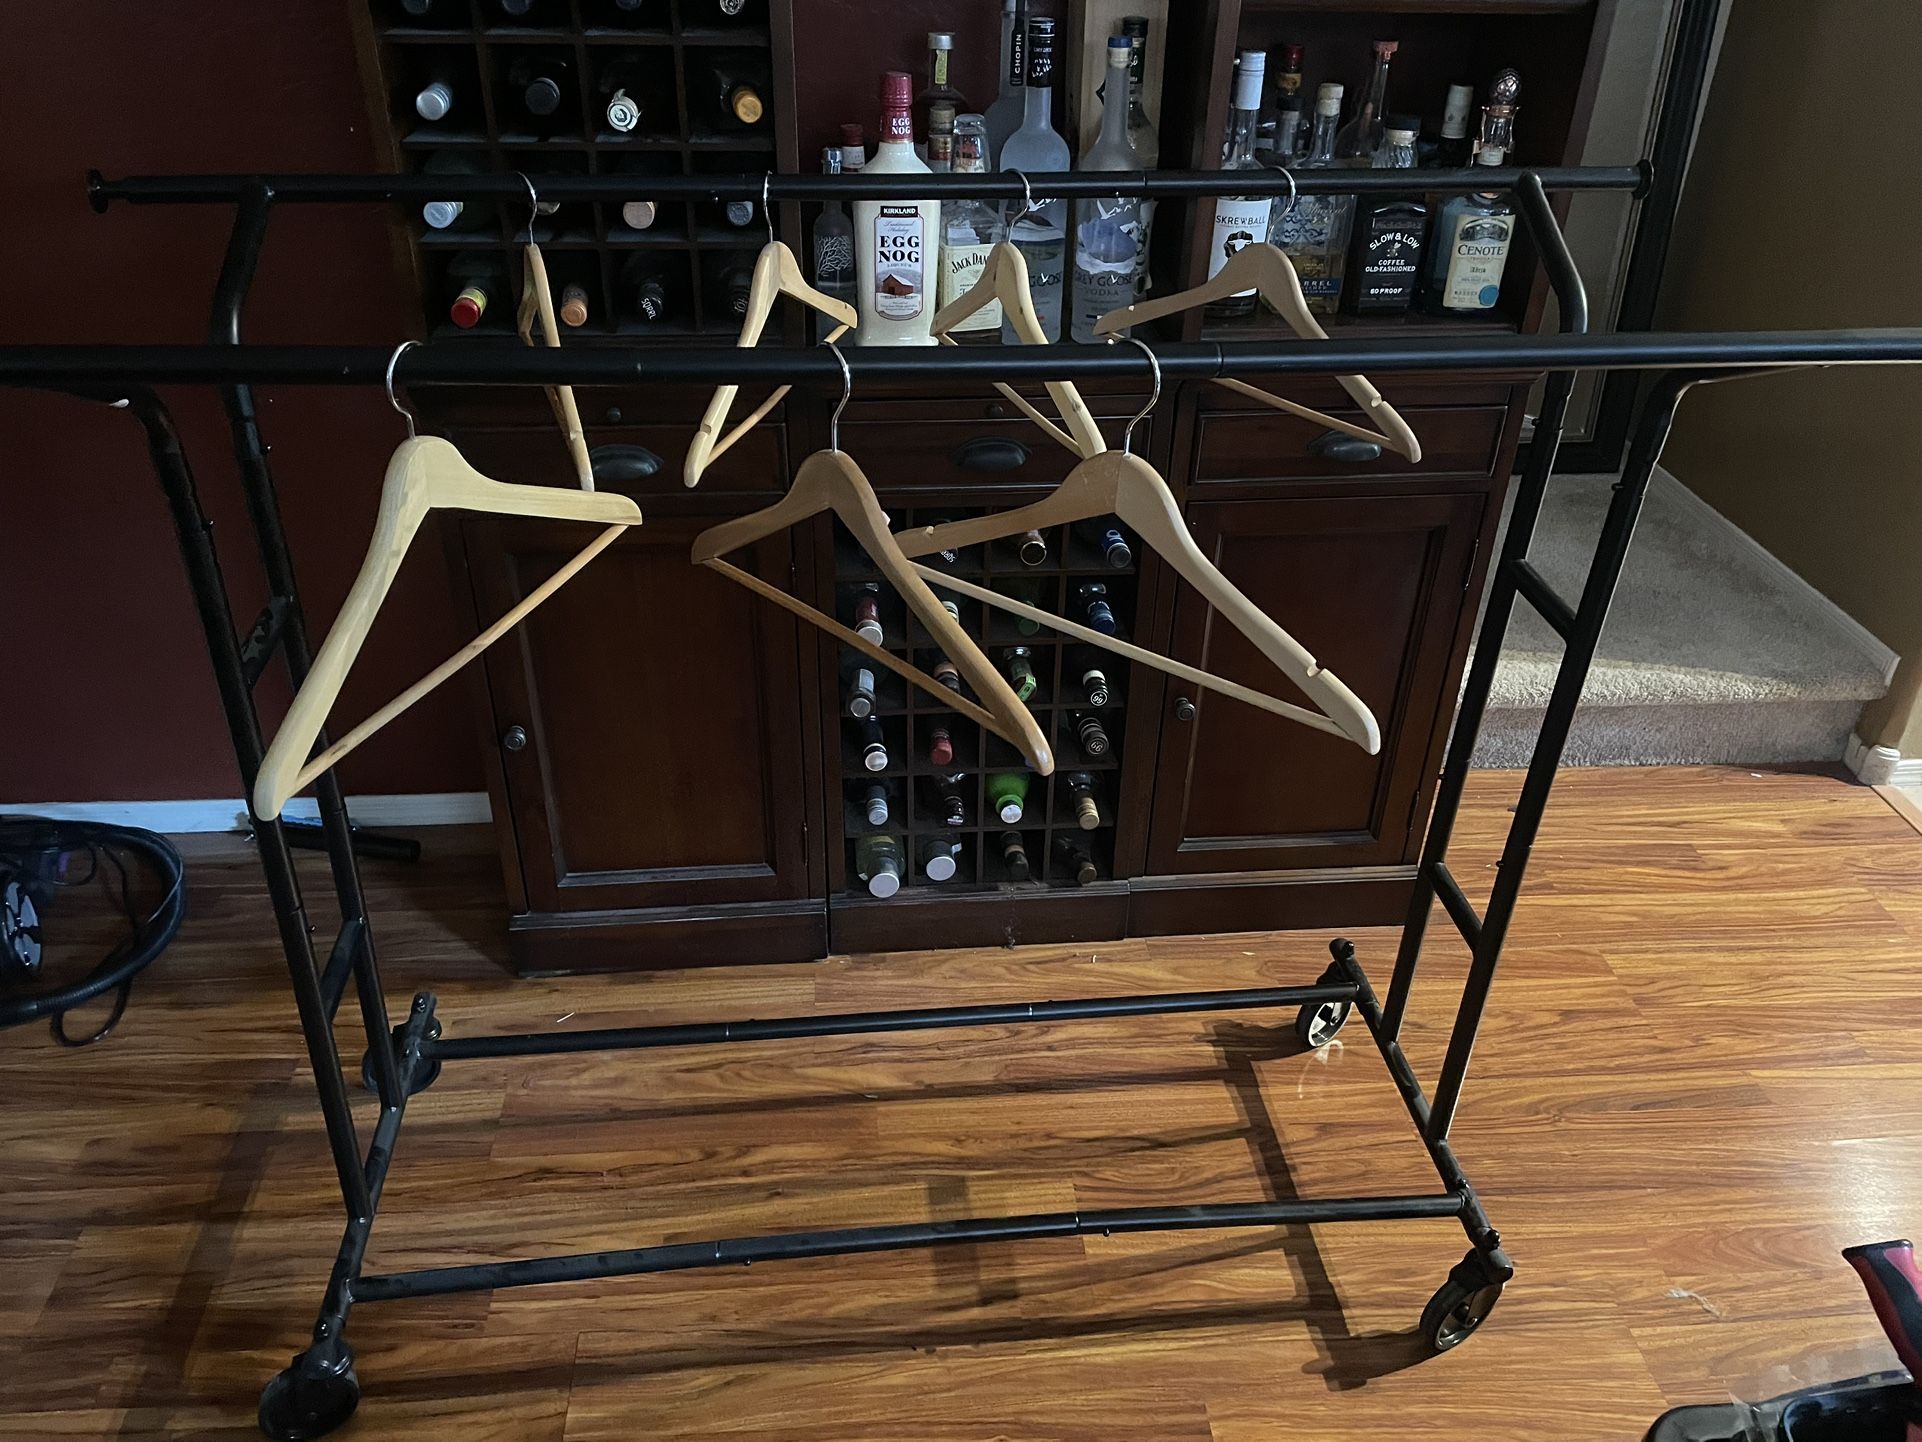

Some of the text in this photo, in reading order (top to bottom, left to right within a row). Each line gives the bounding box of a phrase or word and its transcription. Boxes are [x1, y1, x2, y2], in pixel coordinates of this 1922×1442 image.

[1014, 34, 1022, 74] CHOPIN
[892, 117, 910, 126] EGG
[891, 126, 911, 135] NOG
[1215, 215, 1265, 225] SKREWBALL
[879, 235, 920, 248] EGG
[1369, 232, 1420, 251] SLOW & LOW
[878, 249, 920, 263] NOG
[1457, 243, 1504, 256] CENOTE
[951, 256, 972, 274] JACK
[1365, 265, 1416, 273] OLD-FASHIONED
